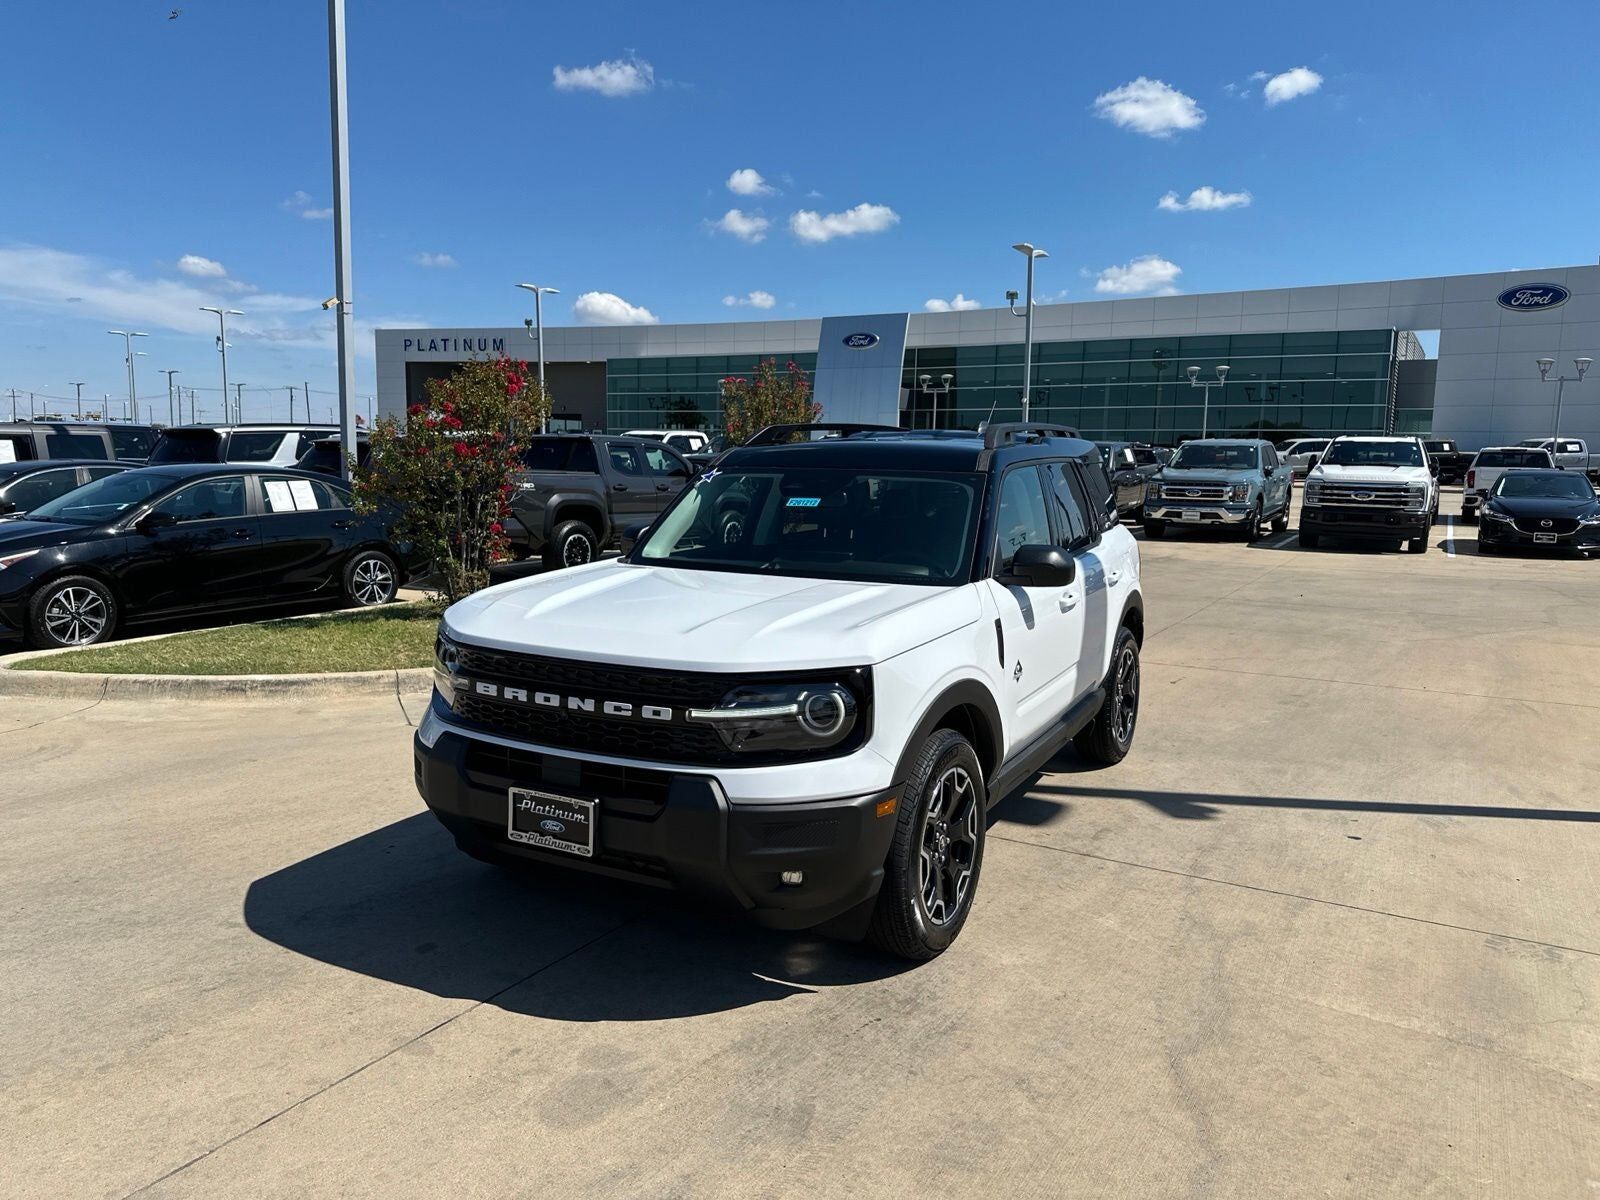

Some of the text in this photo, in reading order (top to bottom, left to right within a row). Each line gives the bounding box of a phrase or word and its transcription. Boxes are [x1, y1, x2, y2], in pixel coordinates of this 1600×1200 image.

[404, 338, 504, 352] PLATINUM
[476, 681, 672, 721] BRONCO
[517, 799, 588, 825] Platinum
[527, 832, 575, 851] Platinum
